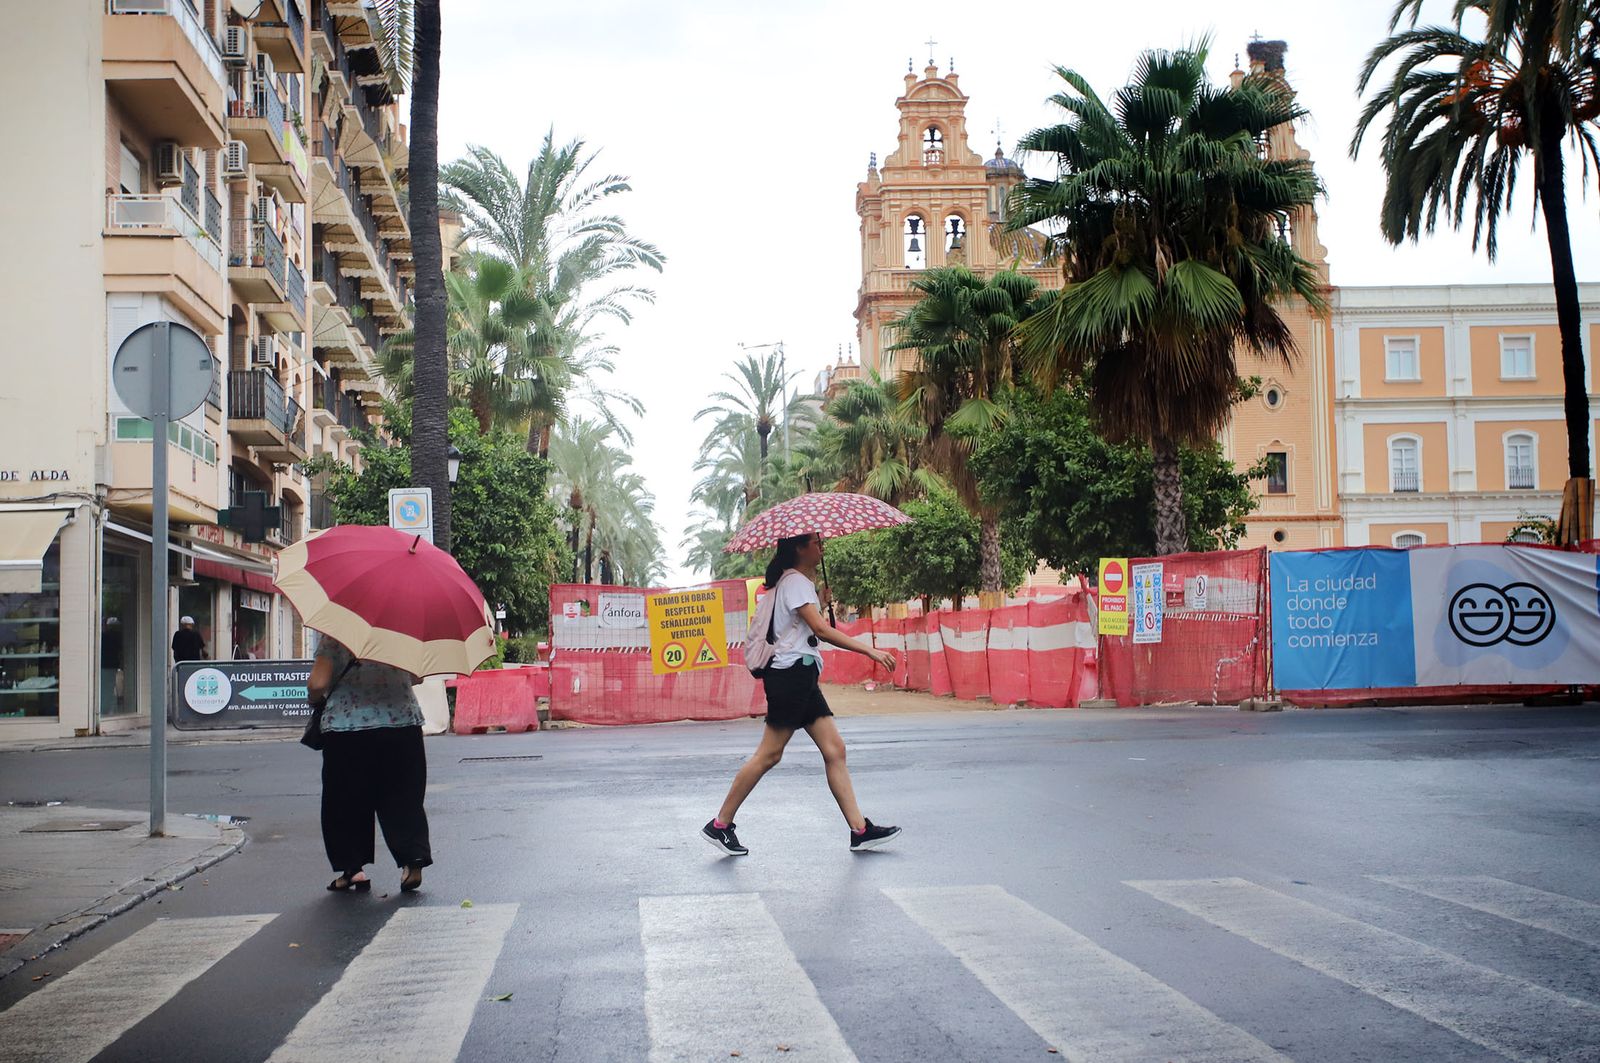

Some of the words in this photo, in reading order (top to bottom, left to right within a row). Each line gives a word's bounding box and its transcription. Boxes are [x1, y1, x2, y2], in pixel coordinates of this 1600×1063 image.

[1, 471, 19, 481] DE
[31, 470, 70, 481] ALDA
[1286, 575, 1309, 592] La
[1314, 572, 1376, 592] ciudad
[653, 596, 680, 606] TRAMO
[681, 595, 690, 603] EN
[691, 591, 716, 602] OBRAS
[1286, 593, 1347, 611] donde
[607, 606, 641, 617] ánfora
[665, 606, 696, 617] RESPETE
[697, 604, 706, 614] LA
[660, 615, 712, 629] SEÑALIZACIÓN
[1287, 612, 1333, 629] todo
[670, 628, 705, 639] VERTICAL
[1287, 630, 1378, 648] comienza
[666, 650, 682, 662] 20
[230, 673, 272, 683] ALQUILER
[281, 689, 306, 697] 100m
